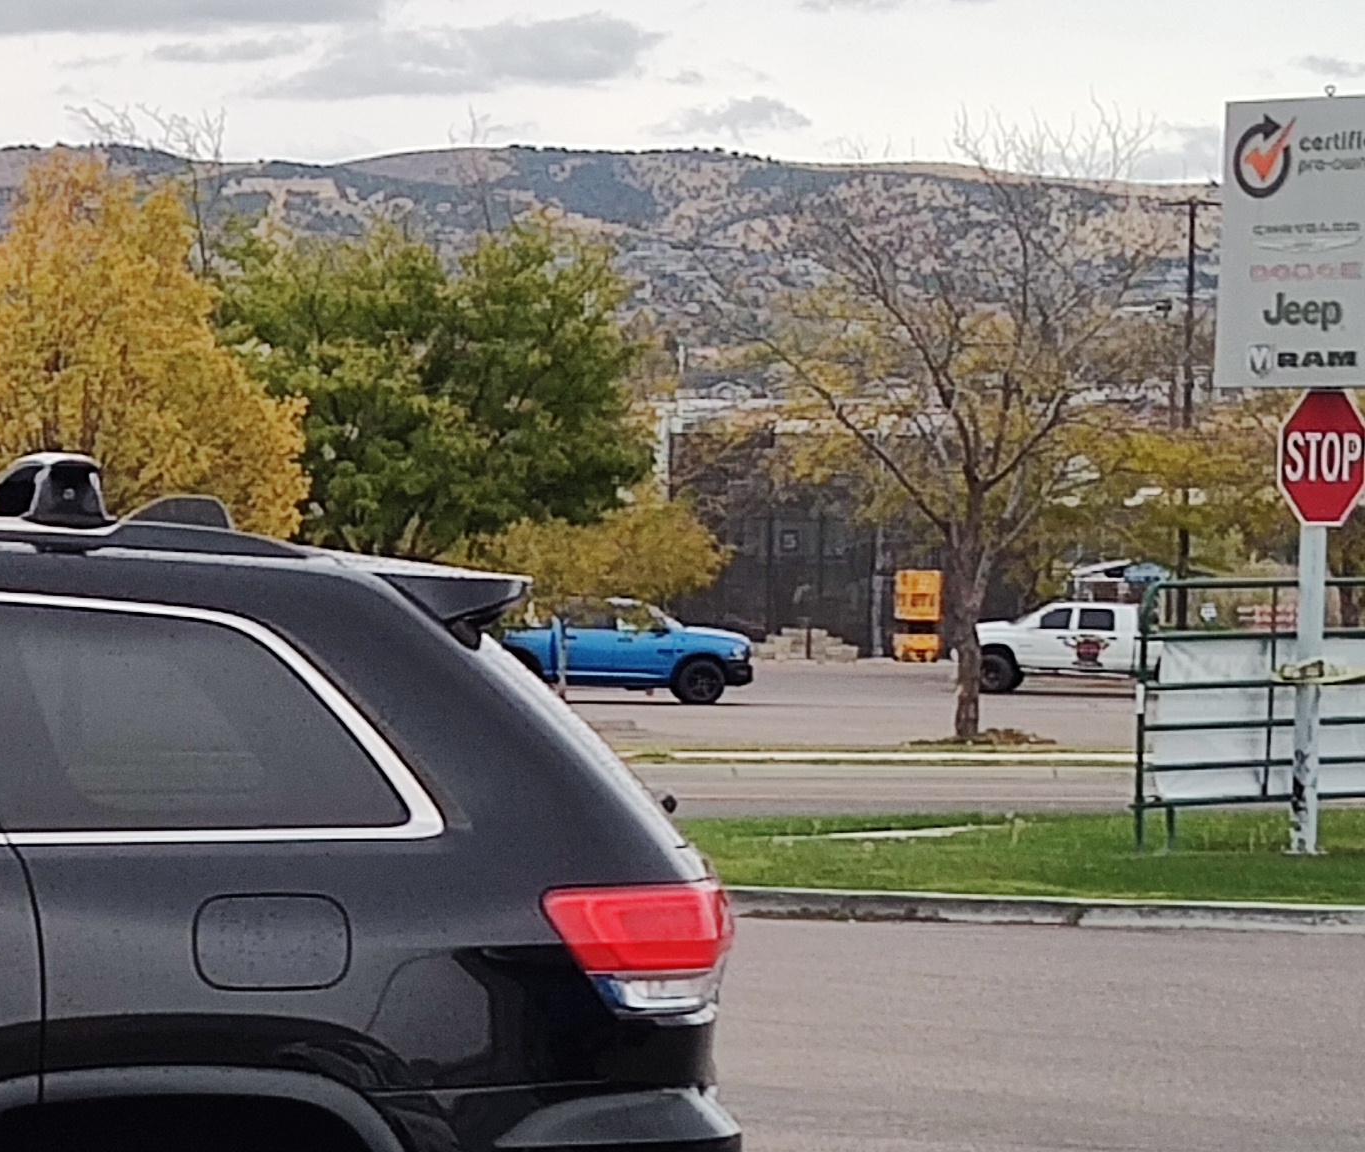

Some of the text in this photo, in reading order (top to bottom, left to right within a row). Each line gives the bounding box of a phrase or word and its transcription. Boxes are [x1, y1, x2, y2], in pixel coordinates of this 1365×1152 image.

[1299, 130, 1365, 152] certifi
[1249, 262, 1362, 282] DODGE
[1262, 292, 1343, 331] Jeep
[1277, 350, 1358, 368] RAM
[1285, 431, 1363, 482] STOP
